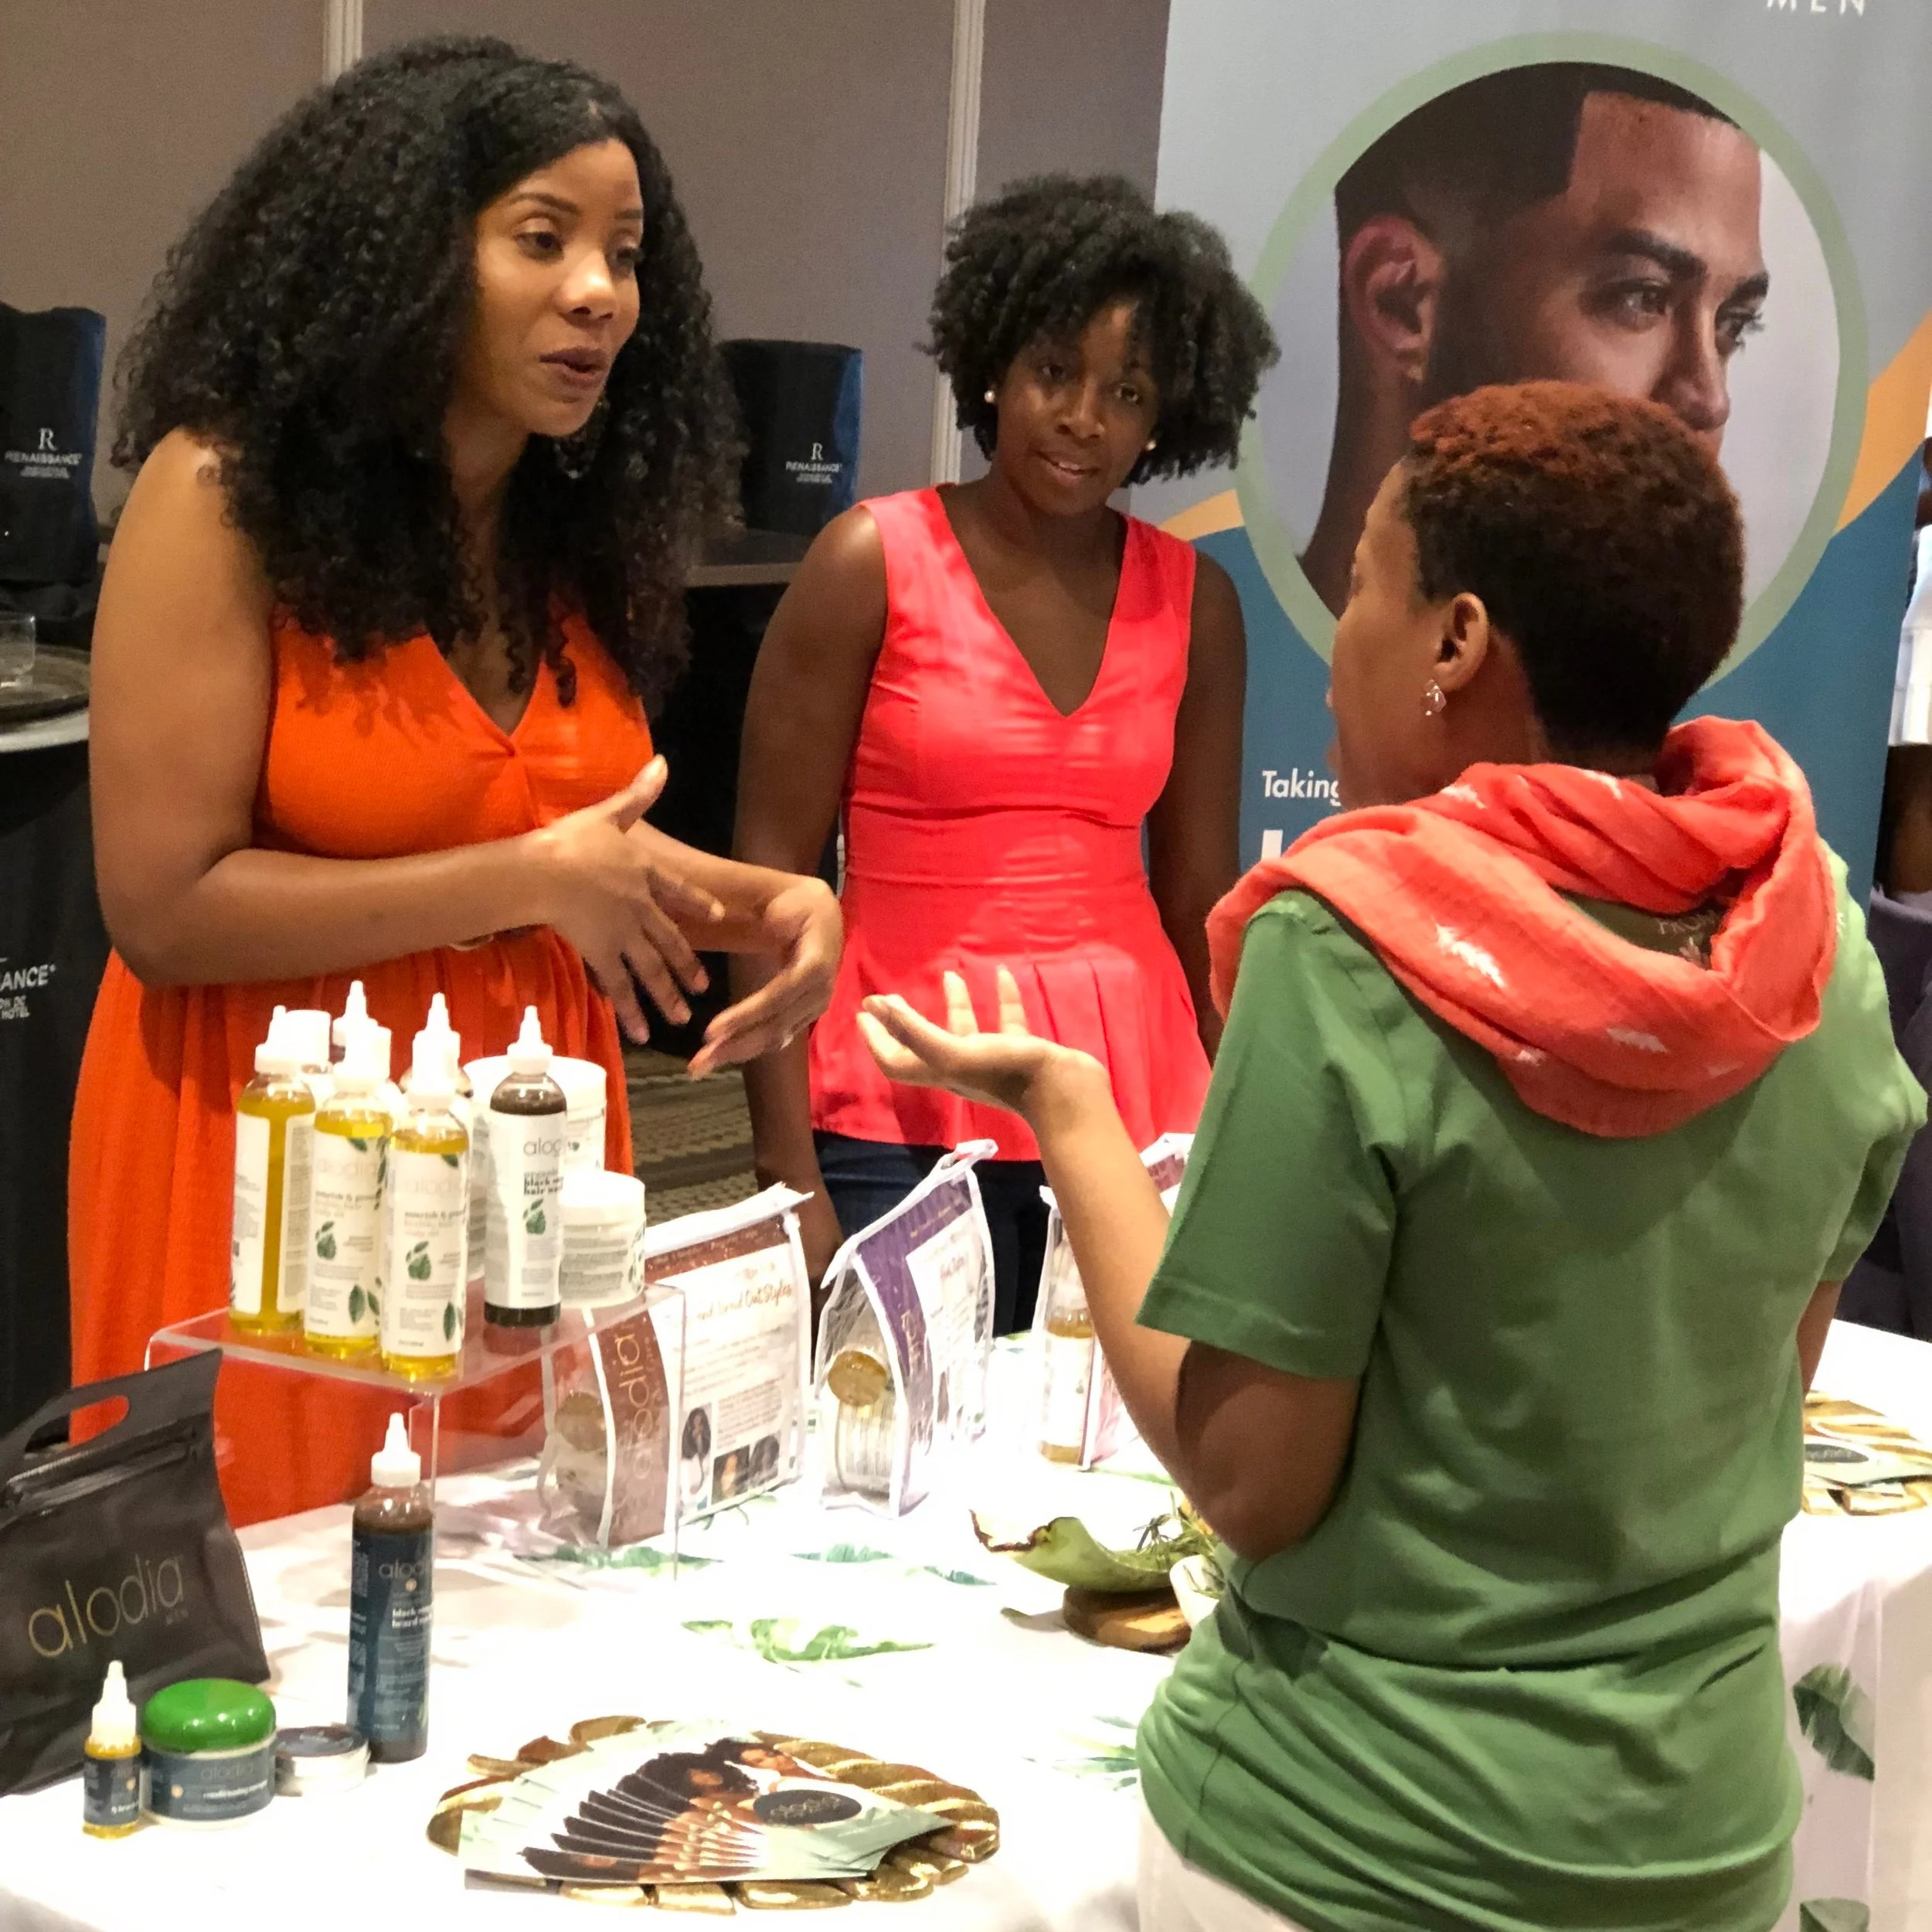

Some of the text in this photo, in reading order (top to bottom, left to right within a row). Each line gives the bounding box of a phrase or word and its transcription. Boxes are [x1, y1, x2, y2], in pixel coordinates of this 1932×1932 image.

[39, 427, 58, 451] R
[811, 442, 825, 461] R
[28, 1553, 184, 1658] alodia
